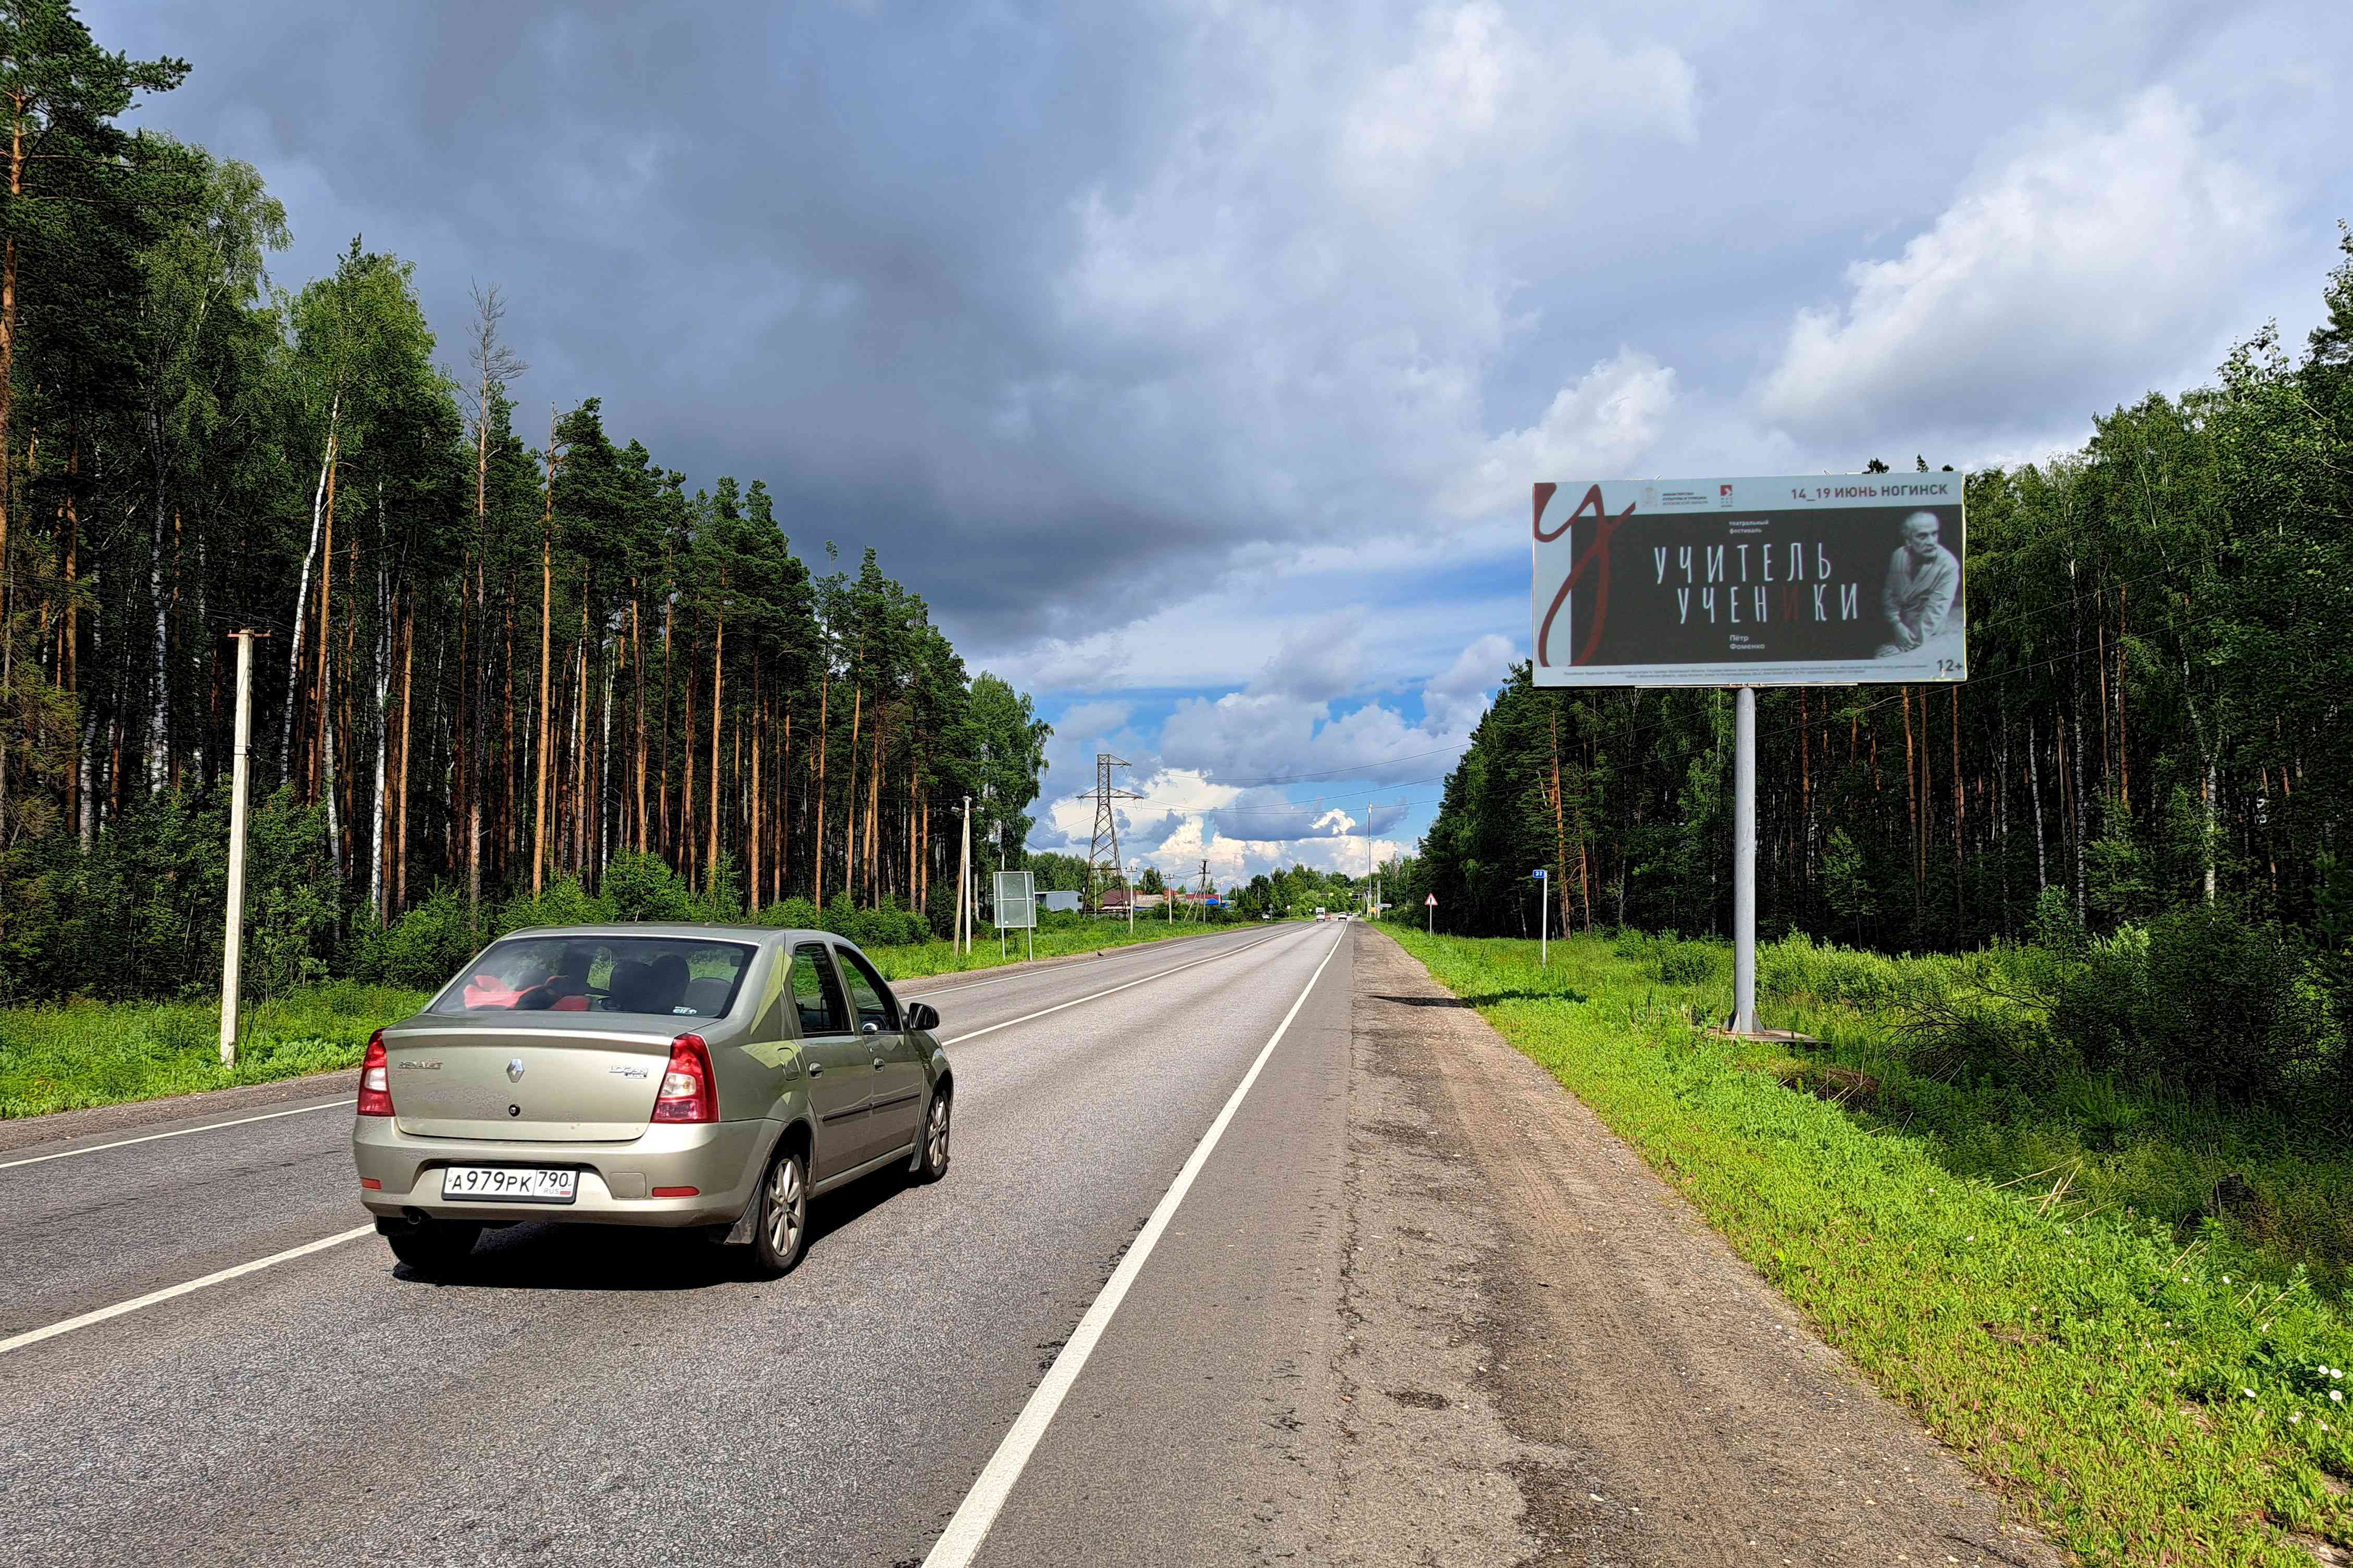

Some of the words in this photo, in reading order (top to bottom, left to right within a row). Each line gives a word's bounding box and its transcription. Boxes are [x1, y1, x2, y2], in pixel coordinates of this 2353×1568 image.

[1834, 486, 1877, 498] ИЮНЬ
[1881, 484, 1948, 496] НОГИНСК
[1654, 542, 1832, 584] УЧИТЕЛЬ
[1677, 582, 1859, 624] УЧЕНИКИ
[1937, 659, 1963, 671] 12+
[451, 1171, 532, 1192] А979РК
[538, 1171, 568, 1187] 790
